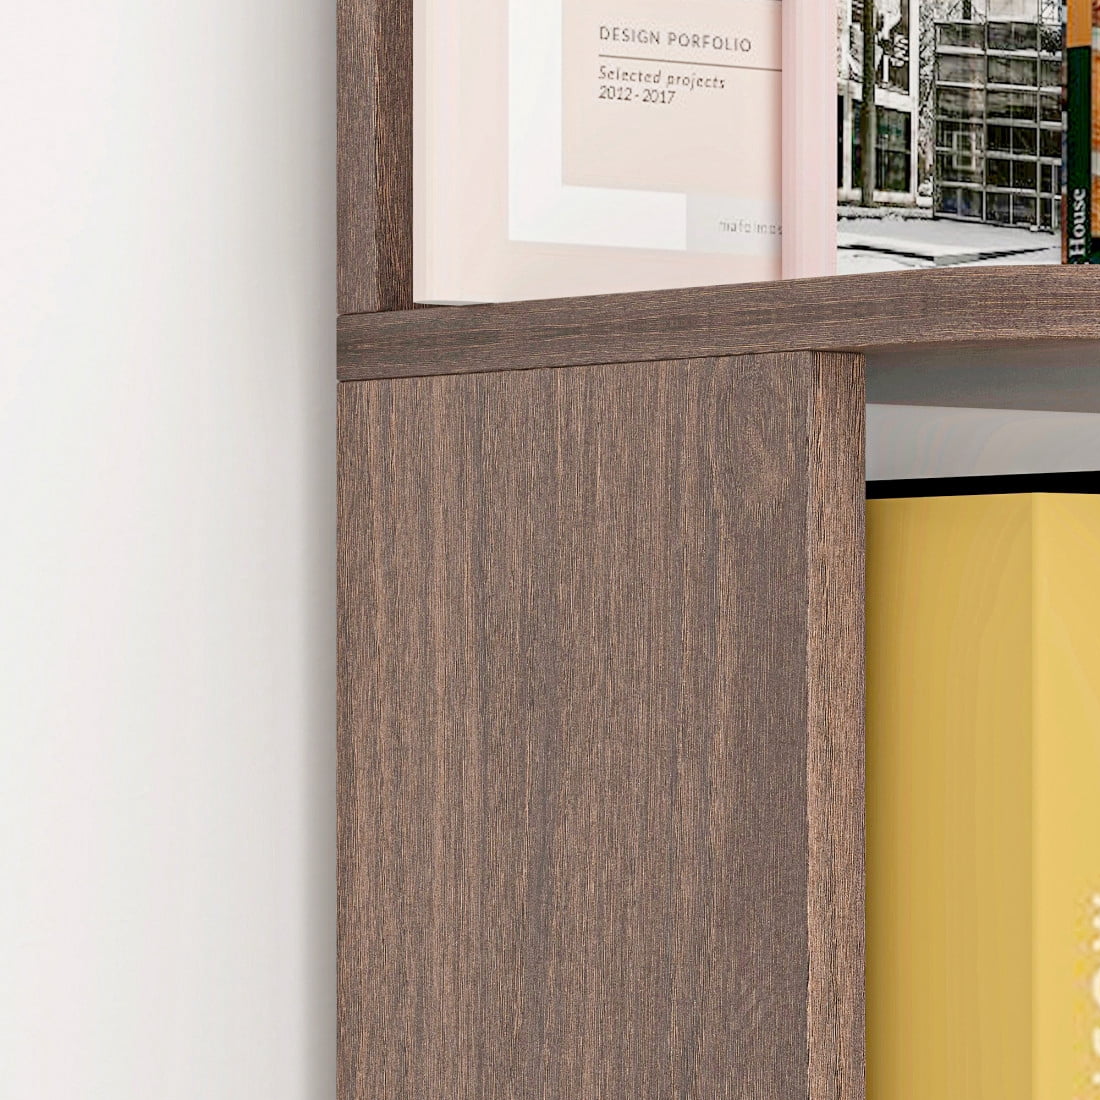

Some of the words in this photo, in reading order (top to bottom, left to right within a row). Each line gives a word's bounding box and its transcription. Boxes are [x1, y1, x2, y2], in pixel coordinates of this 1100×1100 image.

[599, 26, 660, 45] DESIGN
[667, 32, 752, 53] PORFOLIO
[598, 65, 662, 85] Selected
[667, 73, 726, 92] projects
[1068, 188, 1086, 258] House
